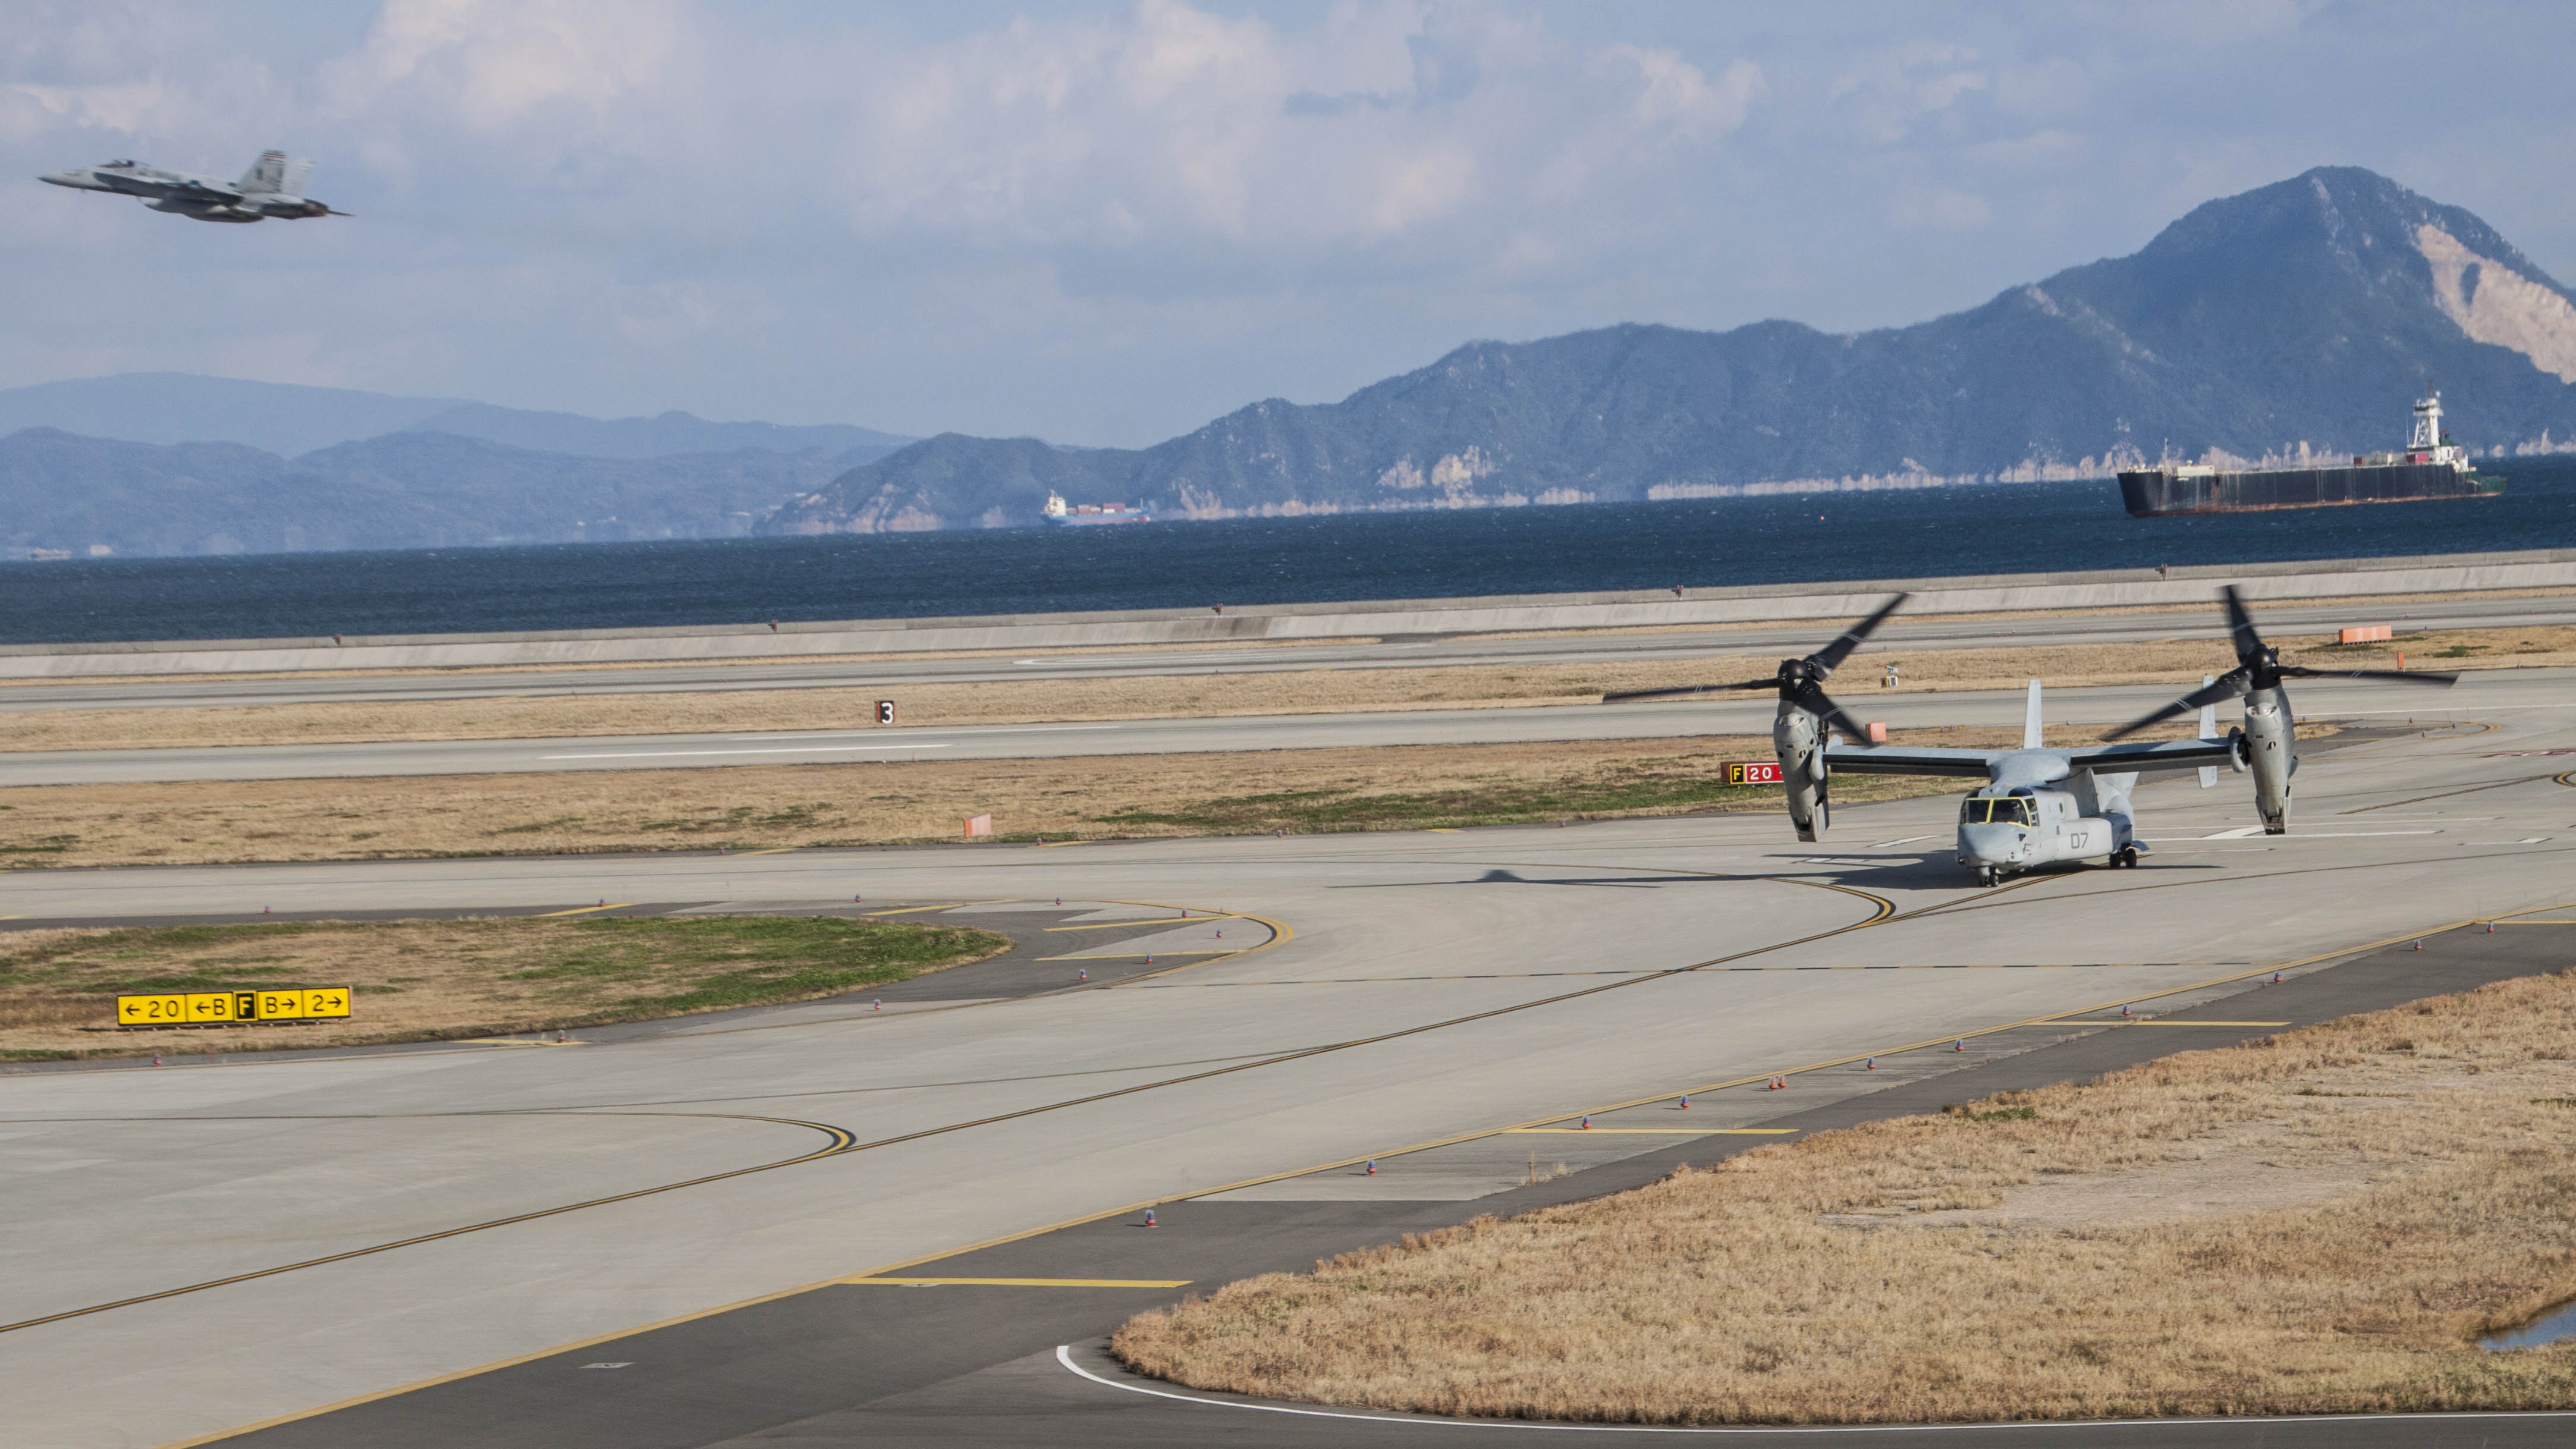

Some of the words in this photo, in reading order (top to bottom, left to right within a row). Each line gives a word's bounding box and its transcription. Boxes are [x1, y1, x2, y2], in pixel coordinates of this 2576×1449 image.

[881, 702, 894, 724] 3
[1733, 768, 1741, 780] F
[1750, 767, 1772, 780] 20
[148, 1000, 178, 1017] 20
[213, 999, 225, 1016] B
[238, 997, 252, 1016] F
[266, 997, 278, 1014] B
[312, 995, 324, 1011] 2
